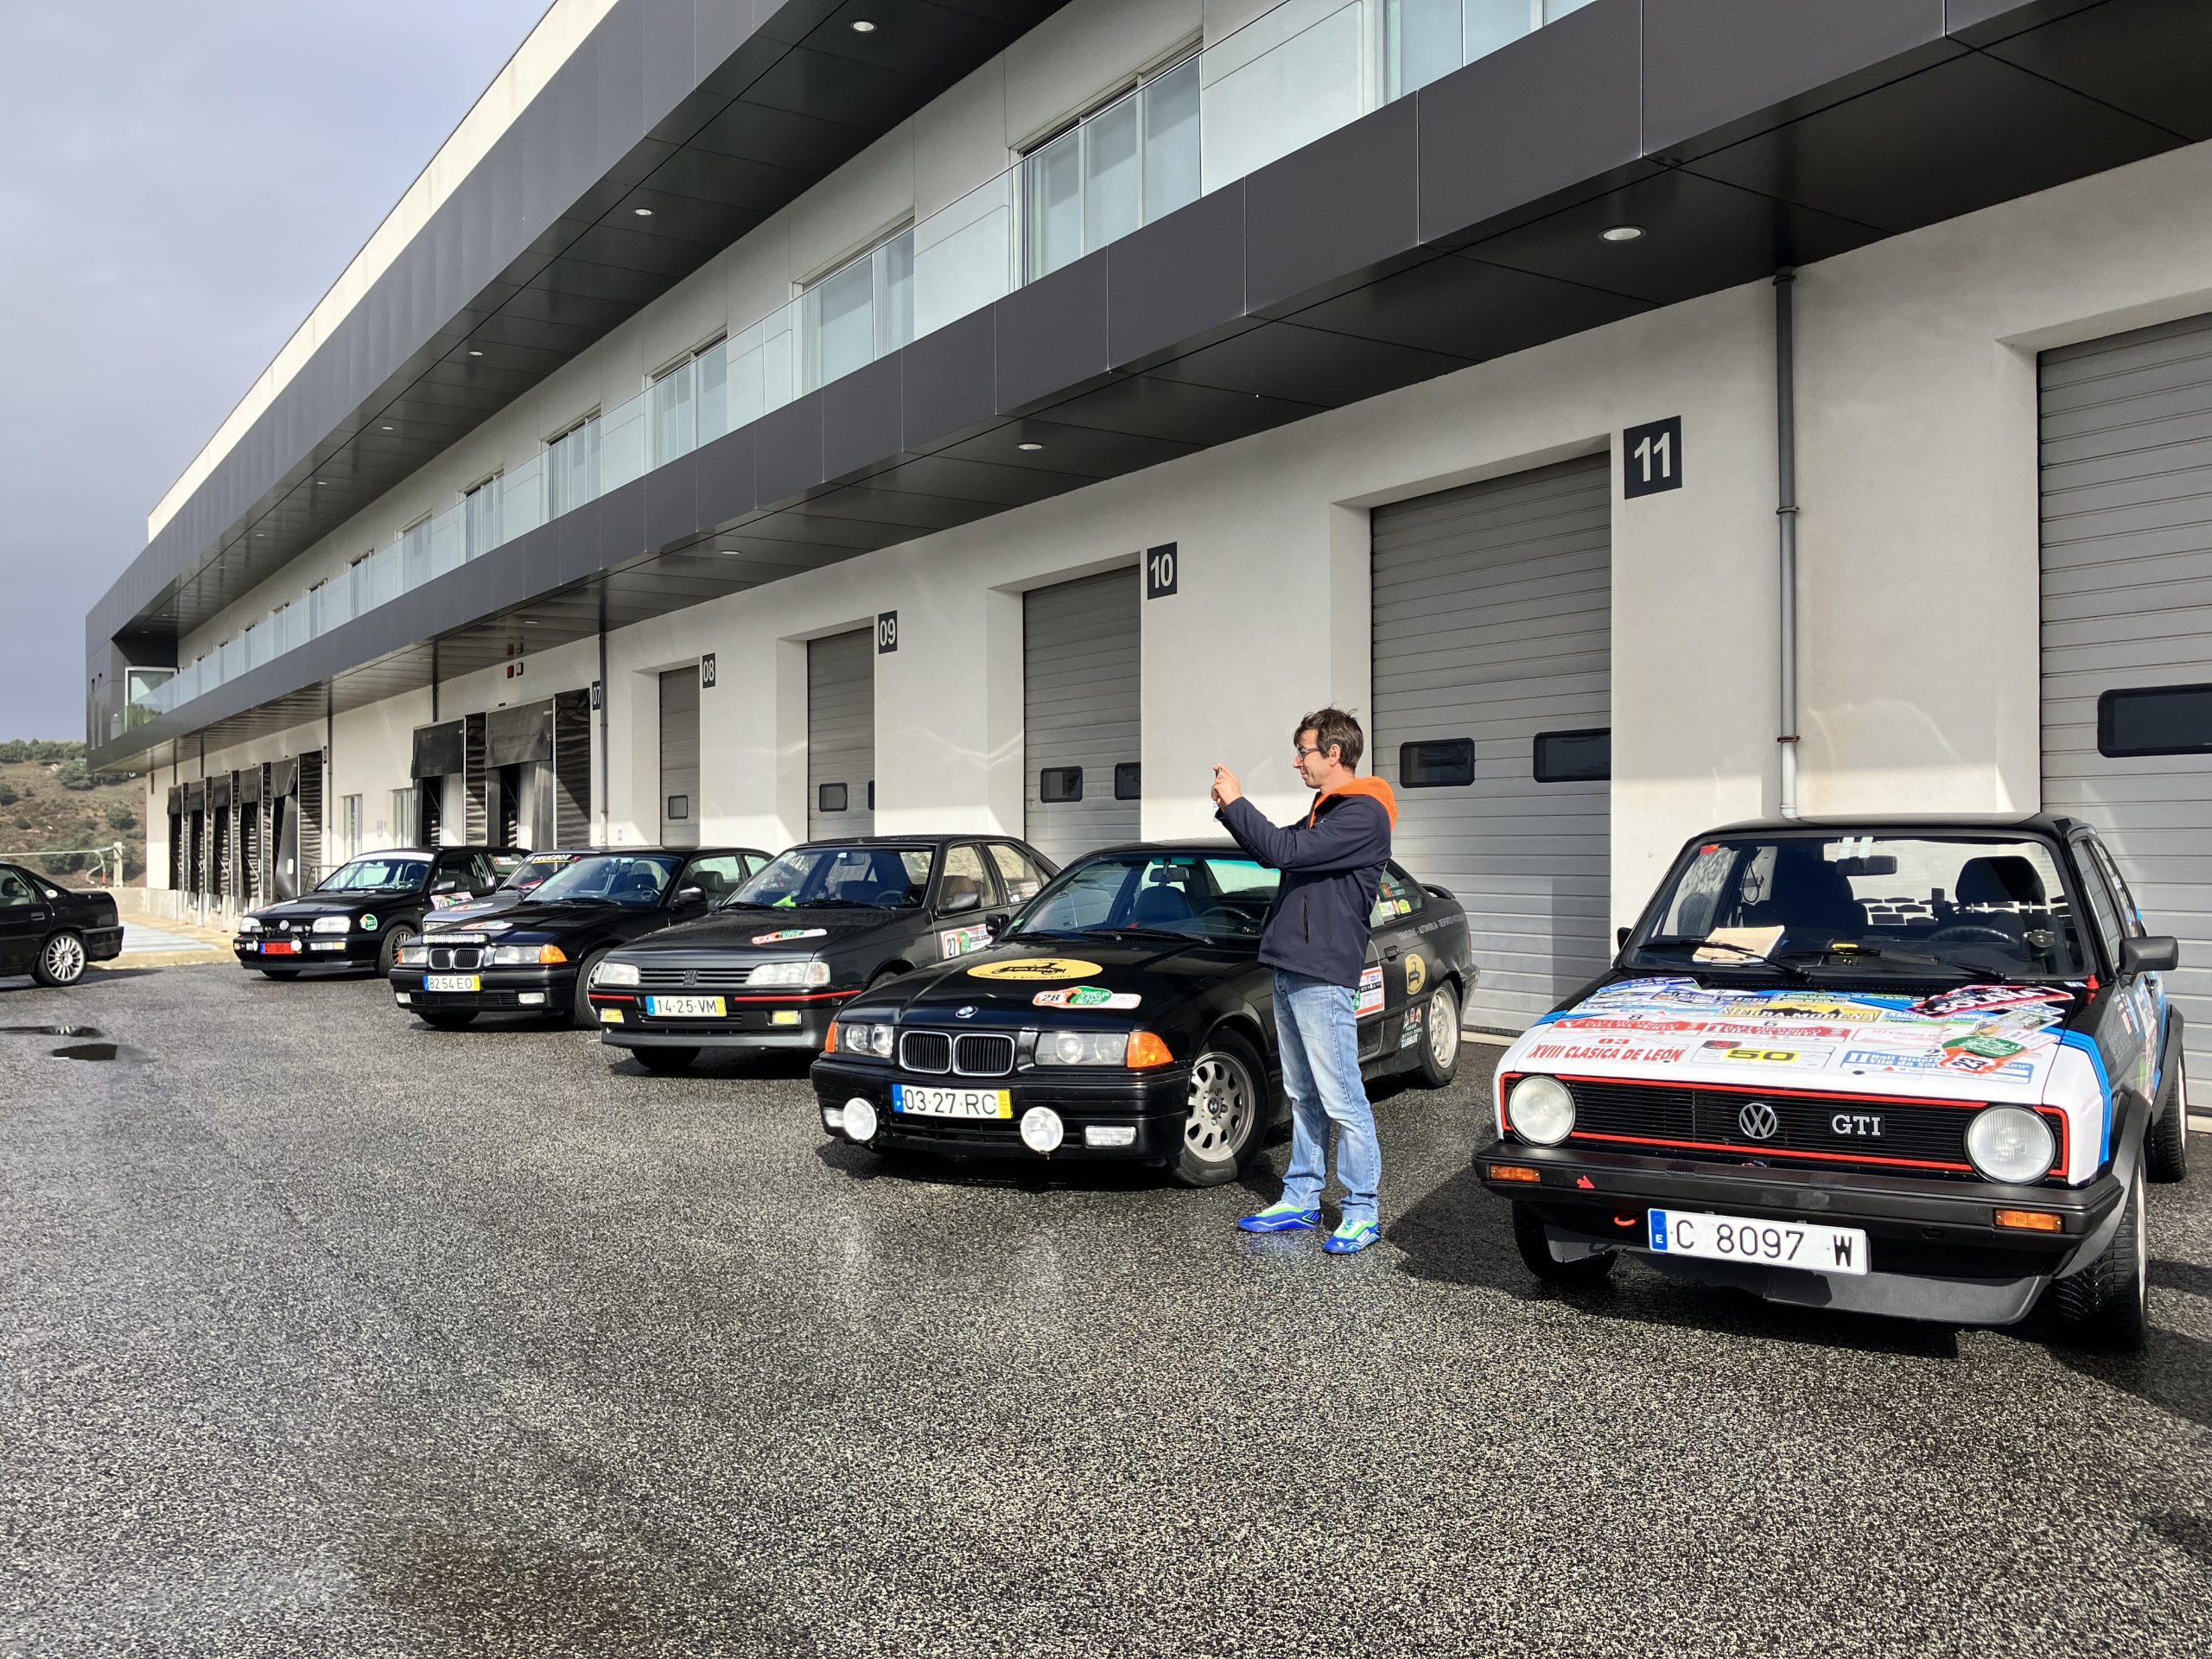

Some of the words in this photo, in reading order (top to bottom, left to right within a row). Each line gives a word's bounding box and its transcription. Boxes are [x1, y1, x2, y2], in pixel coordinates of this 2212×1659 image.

[1634, 431, 1671, 482] 11
[1150, 553, 1173, 588] 10
[879, 619, 896, 646] 09
[703, 659, 715, 683] 08
[947, 938, 956, 957] 27
[429, 977, 440, 989] 82
[442, 977, 454, 989] 54
[658, 1000, 672, 1013] 14
[677, 1000, 694, 1014] 25
[698, 1000, 716, 1014] VM
[1722, 1007, 1786, 1017] SIERRA
[1791, 1012, 1875, 1020] MORENA
[1528, 1045, 1564, 1058] XVIII
[1564, 1046, 1619, 1059] CLASICA
[1621, 1047, 1643, 1060] DE
[1728, 1049, 1796, 1061] 50
[1951, 1058, 1987, 1070] 23
[905, 1089, 926, 1112] 03
[933, 1093, 957, 1115] 27
[965, 1094, 997, 1116] RC
[1832, 1114, 1880, 1136] GTI
[1656, 1234, 1663, 1243] E
[1676, 1219, 1694, 1249] C
[1717, 1224, 1805, 1262] 8097
[1833, 1234, 1853, 1268] W
